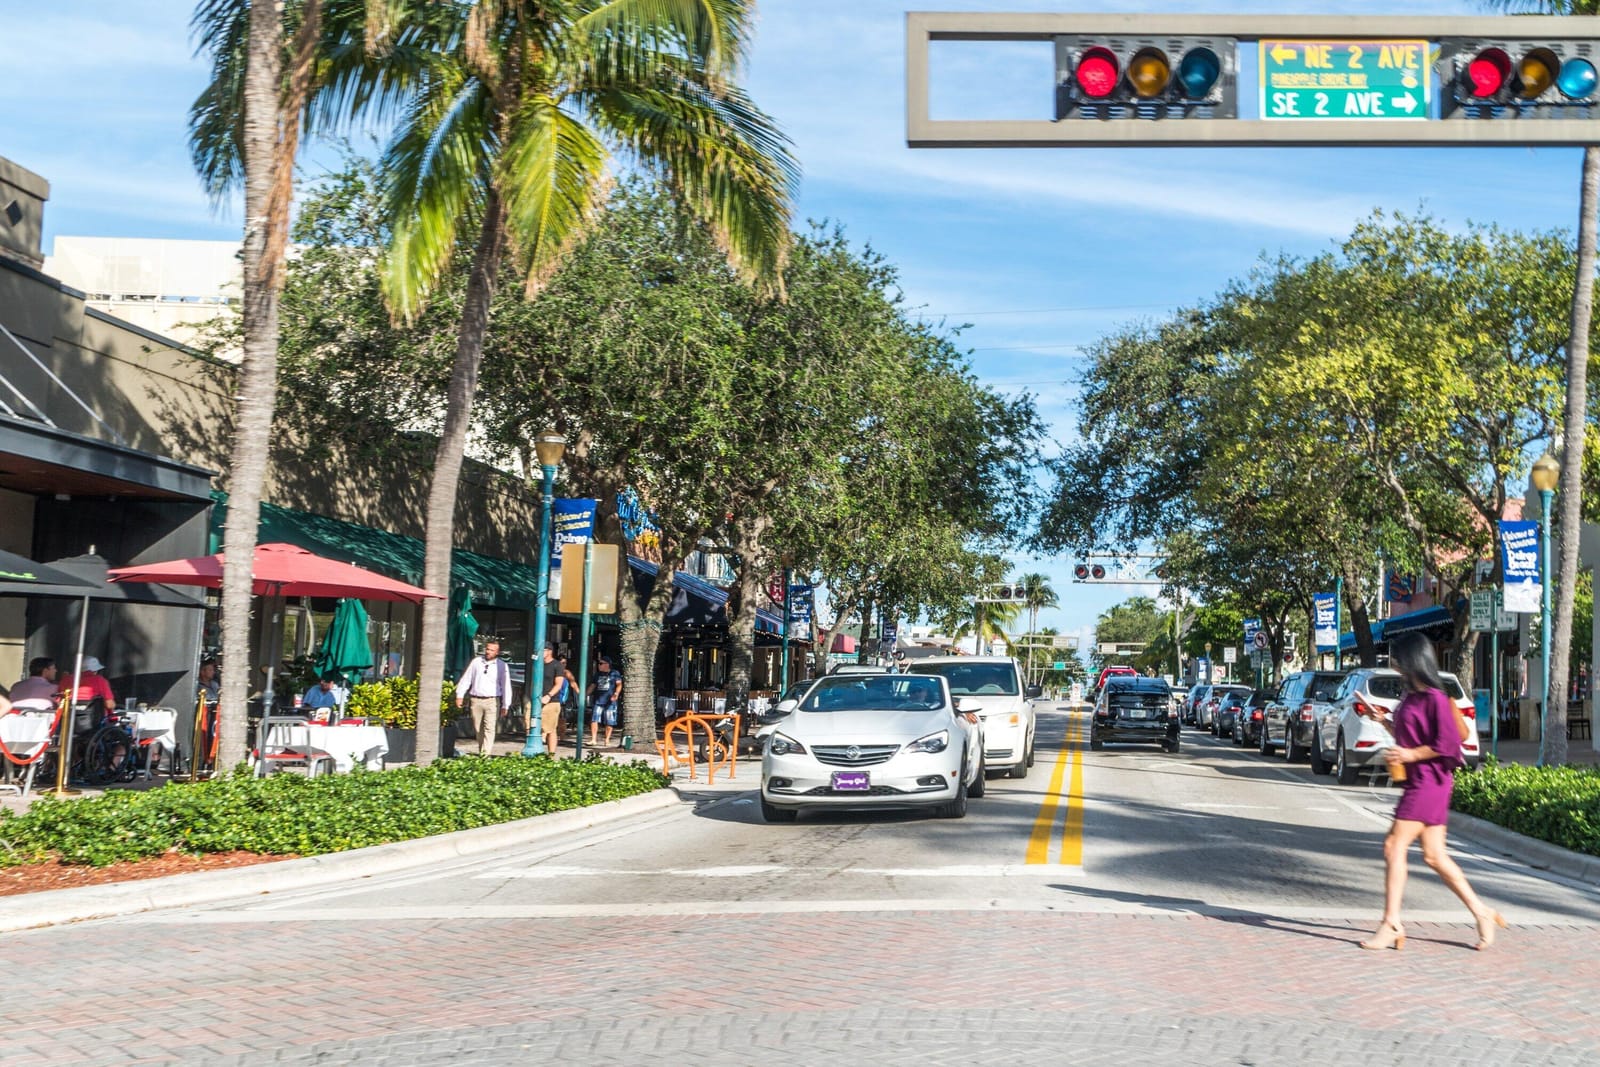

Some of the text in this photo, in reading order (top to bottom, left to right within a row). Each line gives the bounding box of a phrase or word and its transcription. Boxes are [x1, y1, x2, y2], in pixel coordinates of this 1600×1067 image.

[1304, 45, 1420, 69] NE 2 AVE
[1272, 92, 1385, 116] SE 2 AVE
